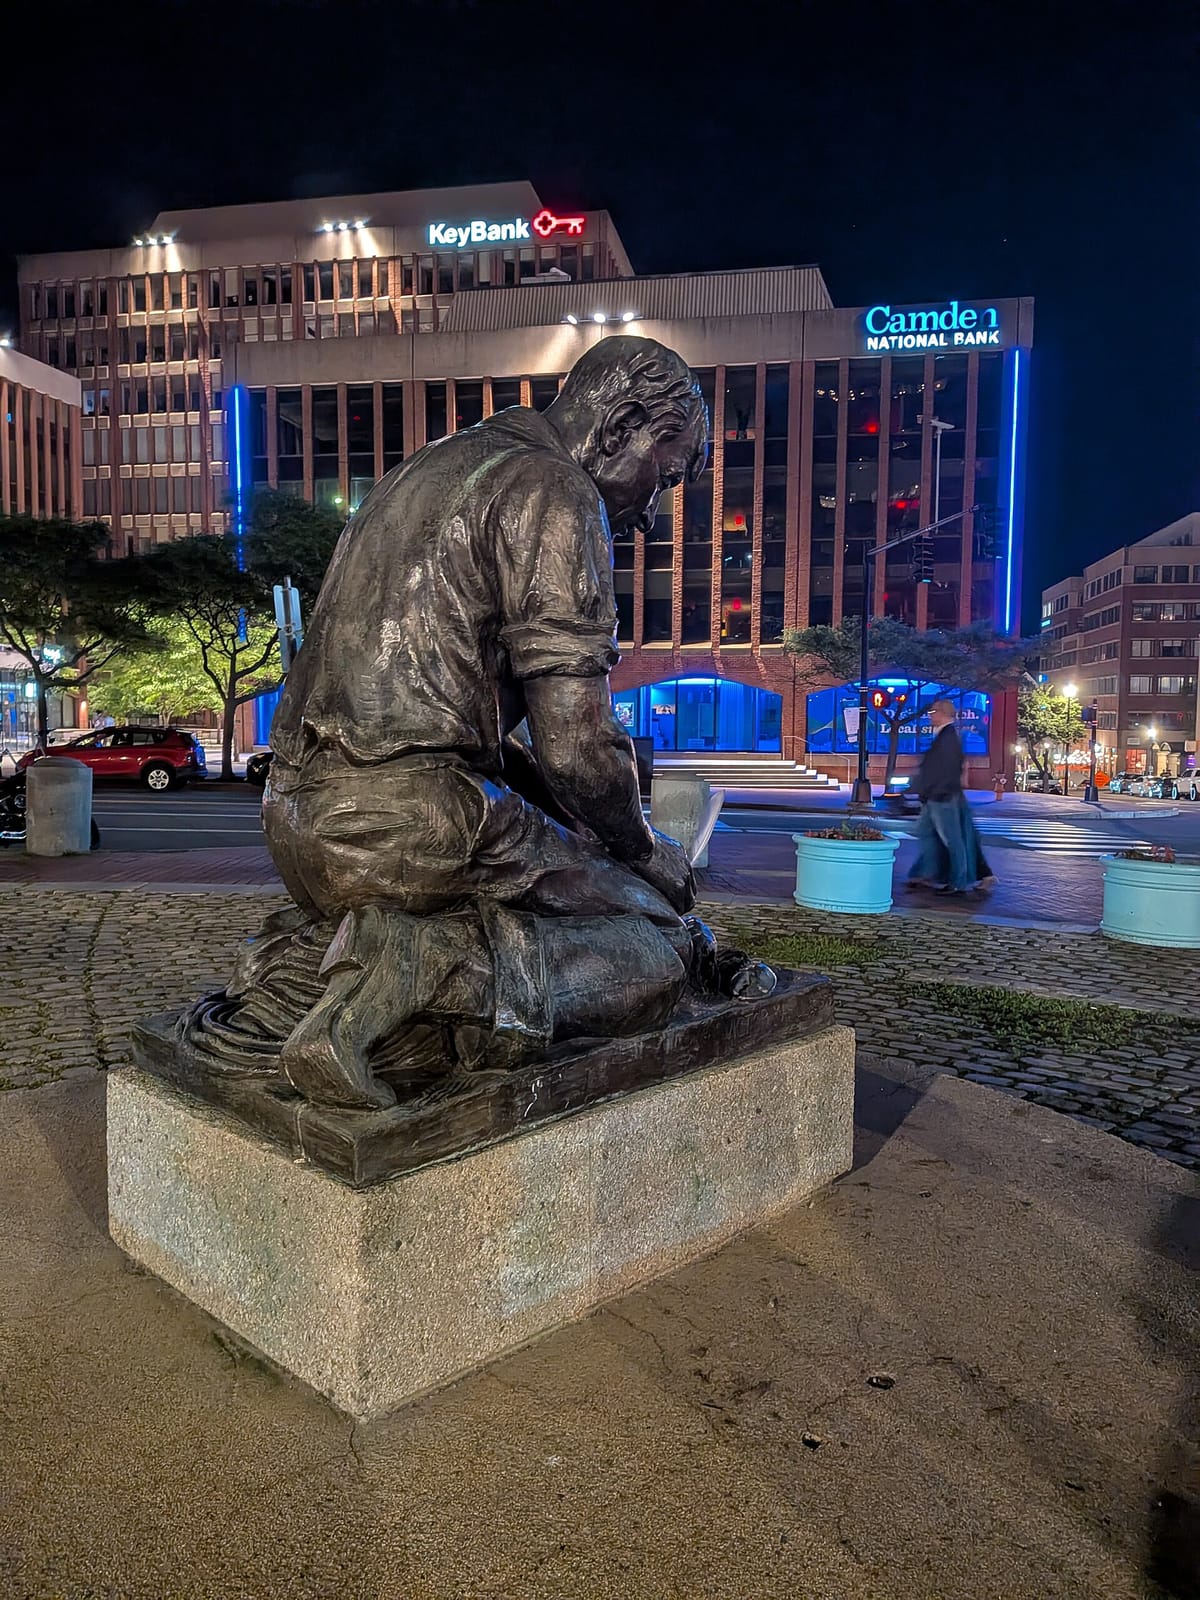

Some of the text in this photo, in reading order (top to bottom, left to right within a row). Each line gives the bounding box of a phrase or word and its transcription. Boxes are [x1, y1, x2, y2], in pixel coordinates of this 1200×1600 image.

[429, 218, 530, 247] KeyBank
[865, 301, 999, 334] Camden
[867, 330, 999, 350] NATIONAL BANK
[880, 723, 917, 734] Lcal
